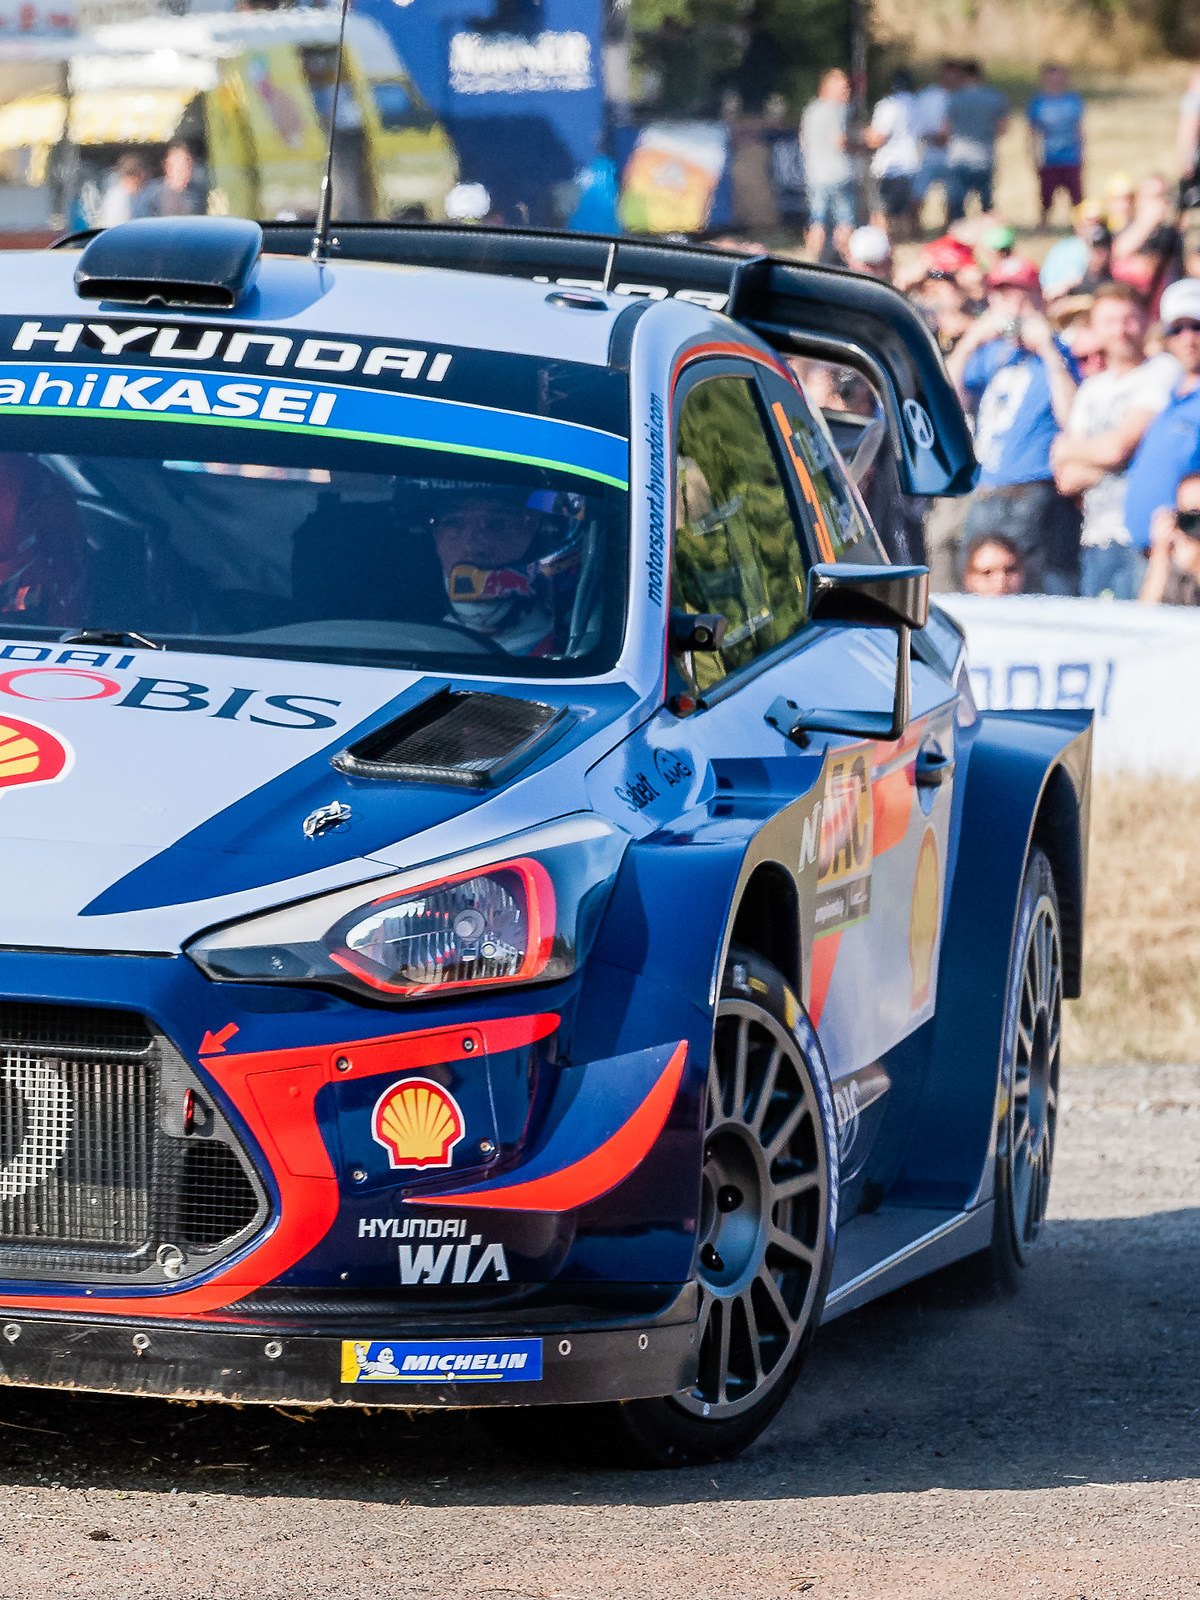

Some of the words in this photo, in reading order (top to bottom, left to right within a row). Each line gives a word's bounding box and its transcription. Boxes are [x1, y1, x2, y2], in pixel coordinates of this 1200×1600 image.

[12, 321, 452, 383] HYUNDAI
[645, 392, 666, 607] motorsport.hyundai.com
[358, 1218, 468, 1238] HYUNDAI
[401, 1353, 528, 1371] MICHELIN
